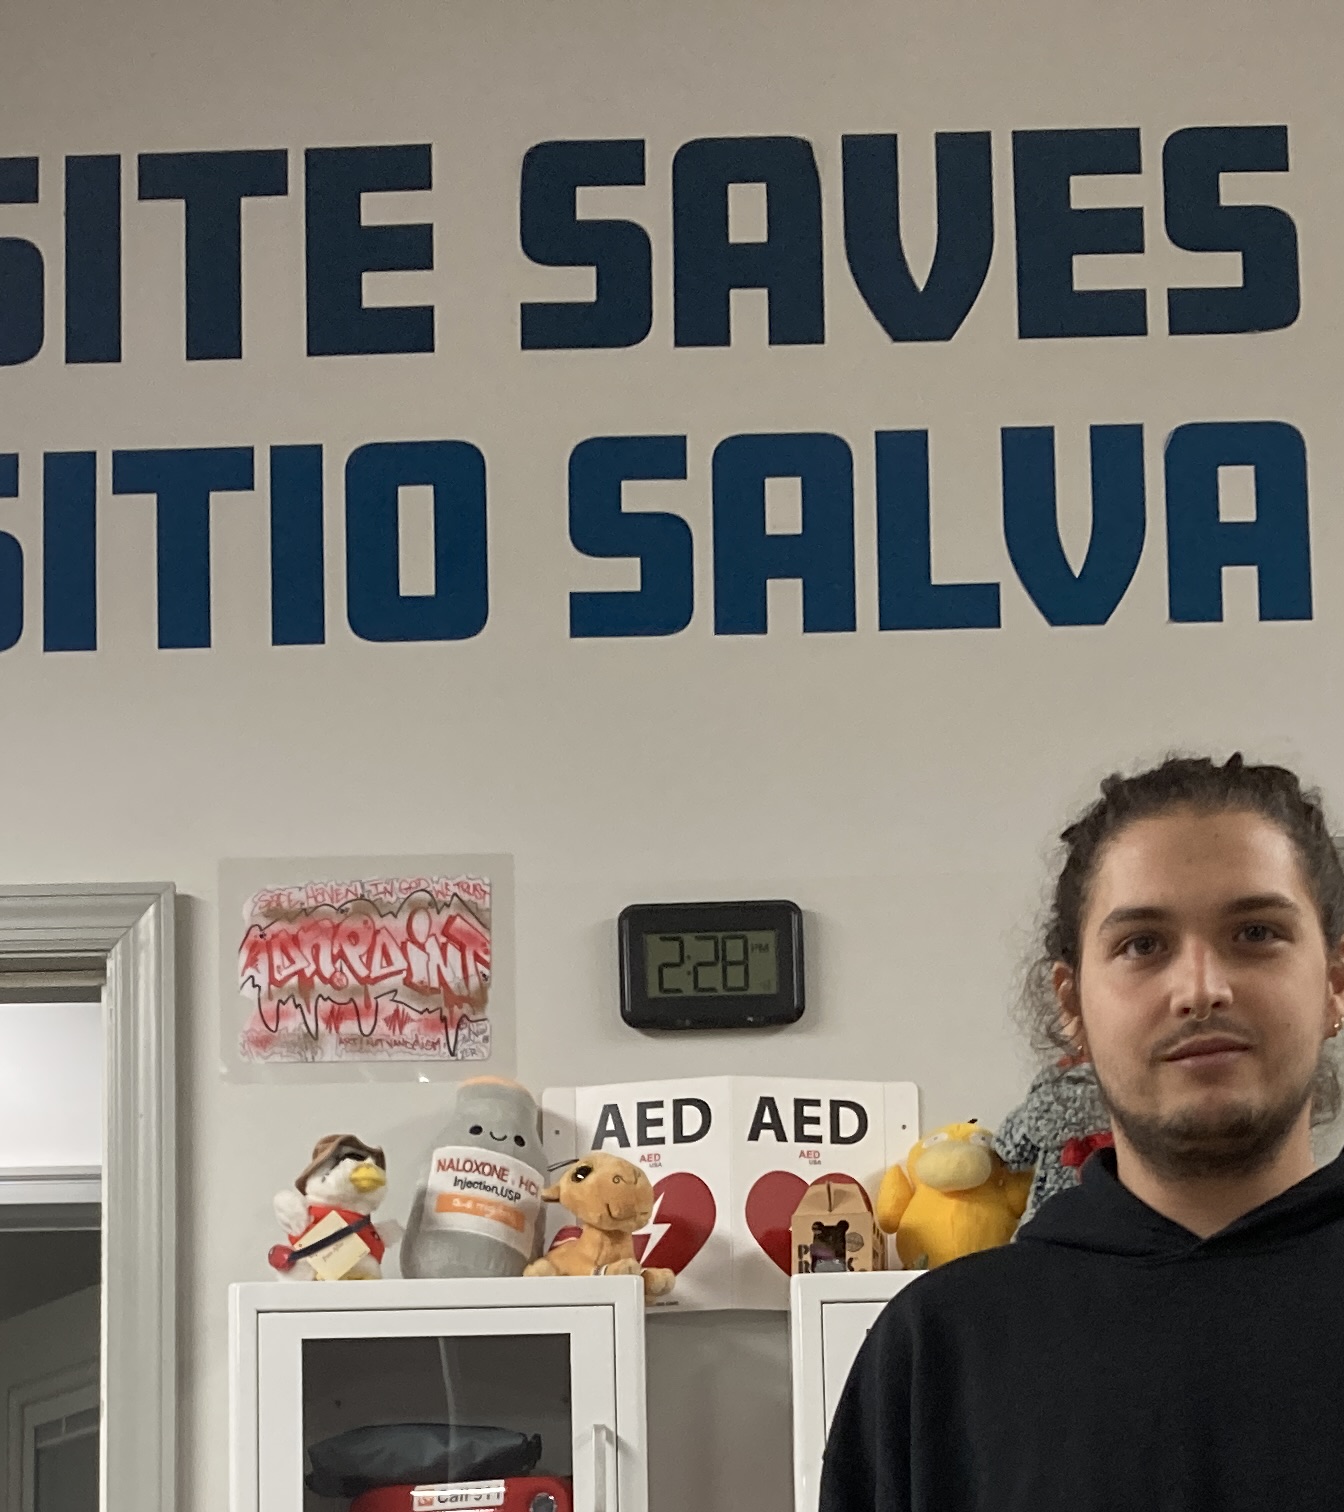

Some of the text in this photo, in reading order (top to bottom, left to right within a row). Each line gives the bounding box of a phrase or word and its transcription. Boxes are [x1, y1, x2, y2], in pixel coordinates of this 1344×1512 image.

[519, 125, 1302, 351] SAVES
[566, 420, 1315, 638] SALVA
[369, 881, 394, 898] IN
[399, 878, 431, 895] GOD
[657, 934, 769, 995] 2:28 PM
[591, 1096, 713, 1150] AED
[747, 1096, 869, 1145] AED
[436, 1157, 510, 1183] NALOXONE
[639, 1153, 662, 1163] AED
[799, 1150, 821, 1159] AED
